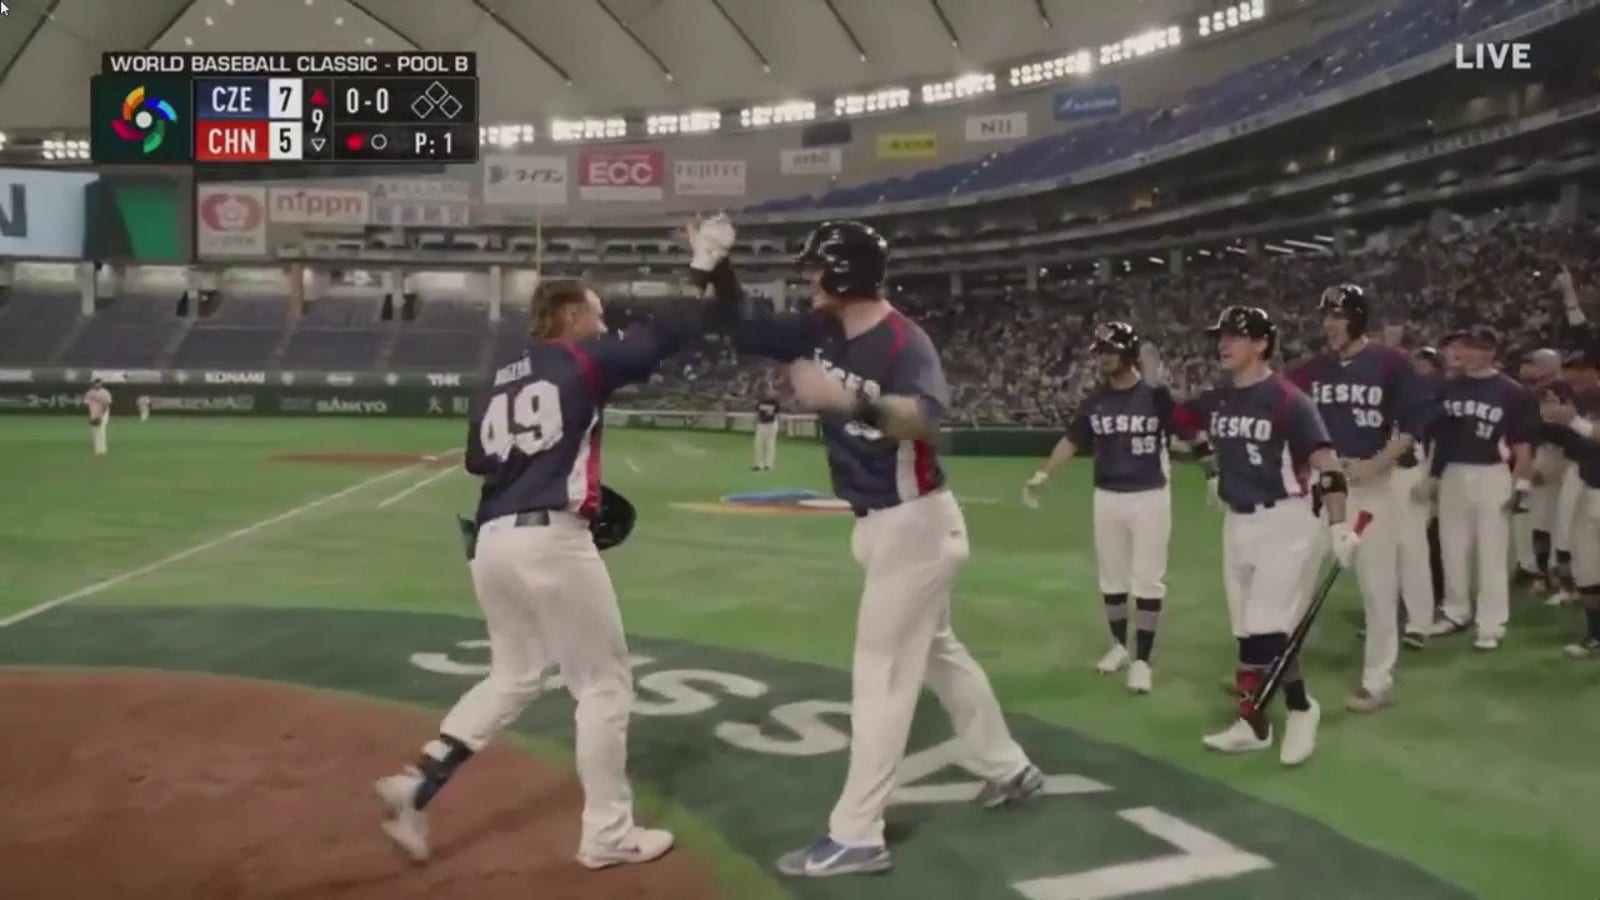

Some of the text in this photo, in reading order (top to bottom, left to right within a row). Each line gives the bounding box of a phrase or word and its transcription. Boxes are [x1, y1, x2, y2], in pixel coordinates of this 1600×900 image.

[588, 162, 652, 184] ECC
[205, 371, 266, 384] KONAMI
[480, 379, 564, 462] 49
[1352, 408, 1384, 428] 30
[1246, 442, 1263, 466] 5
